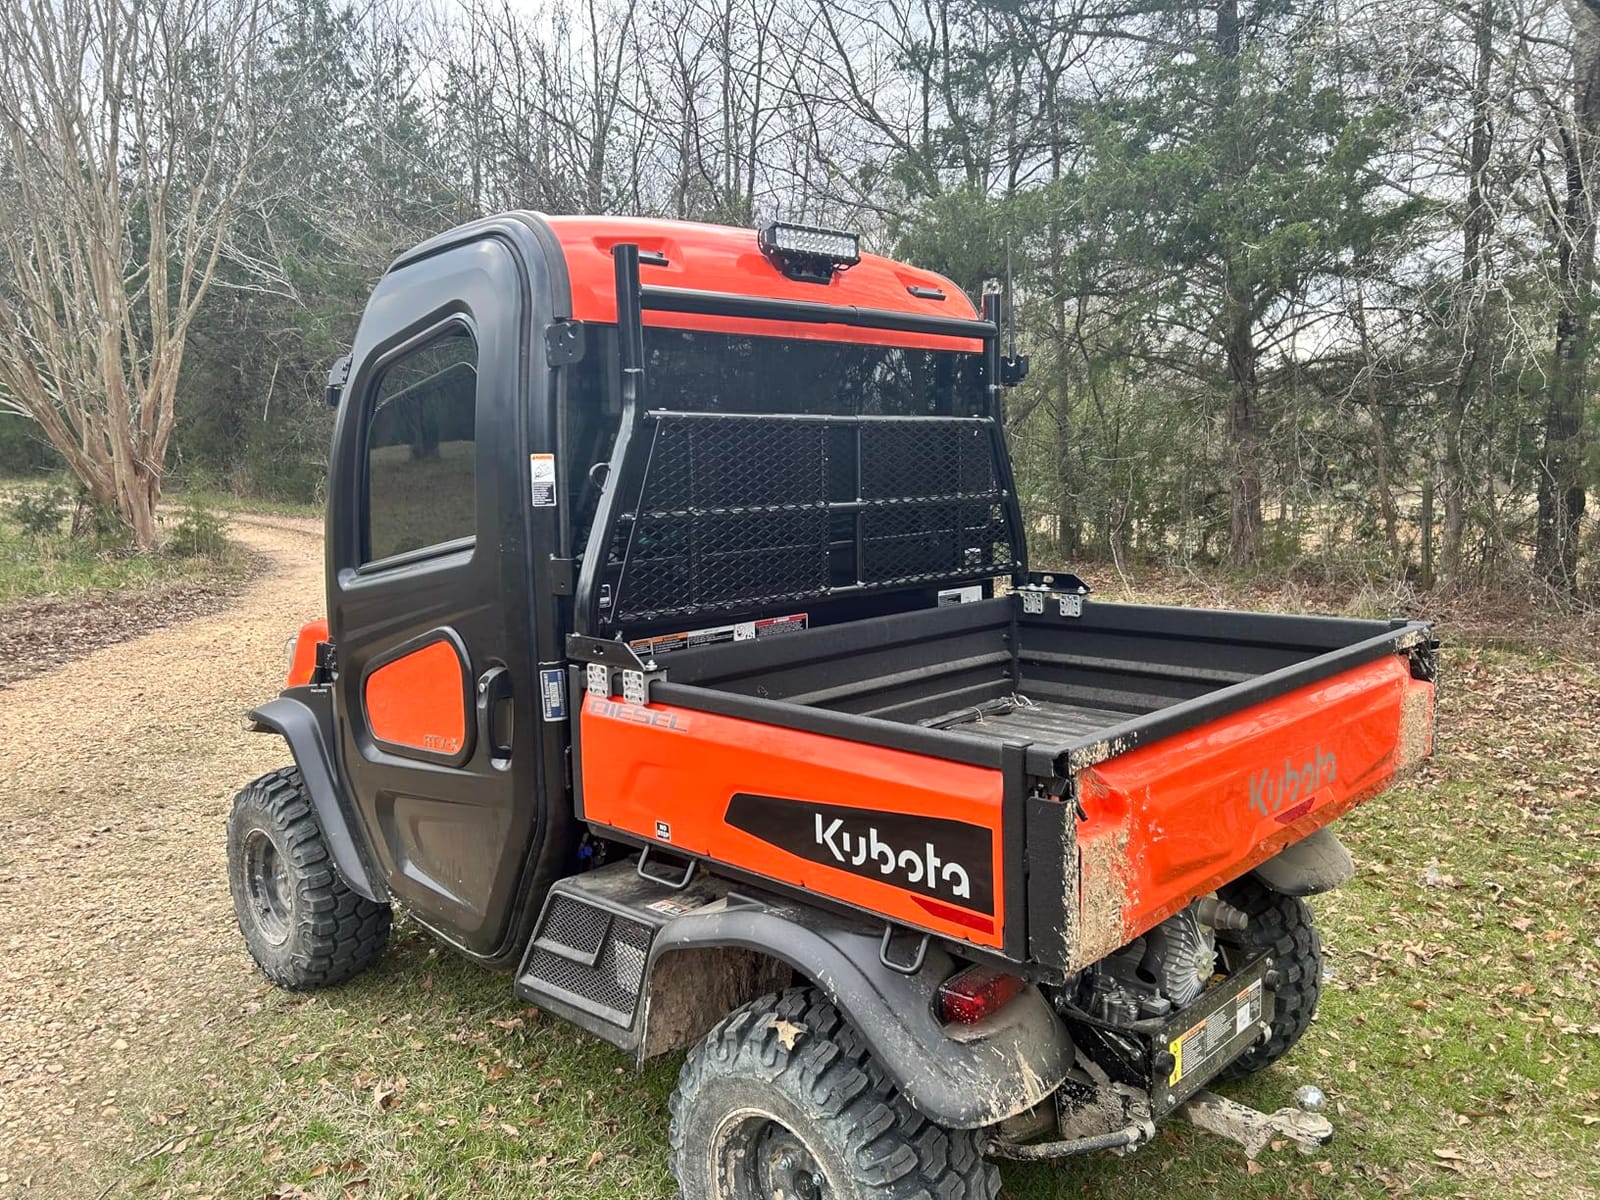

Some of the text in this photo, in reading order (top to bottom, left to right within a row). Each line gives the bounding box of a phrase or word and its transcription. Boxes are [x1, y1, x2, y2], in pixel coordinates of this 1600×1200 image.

[590, 701, 687, 732] DIESEL
[1249, 745, 1336, 817] Kubota
[815, 813, 970, 899] Kubota
